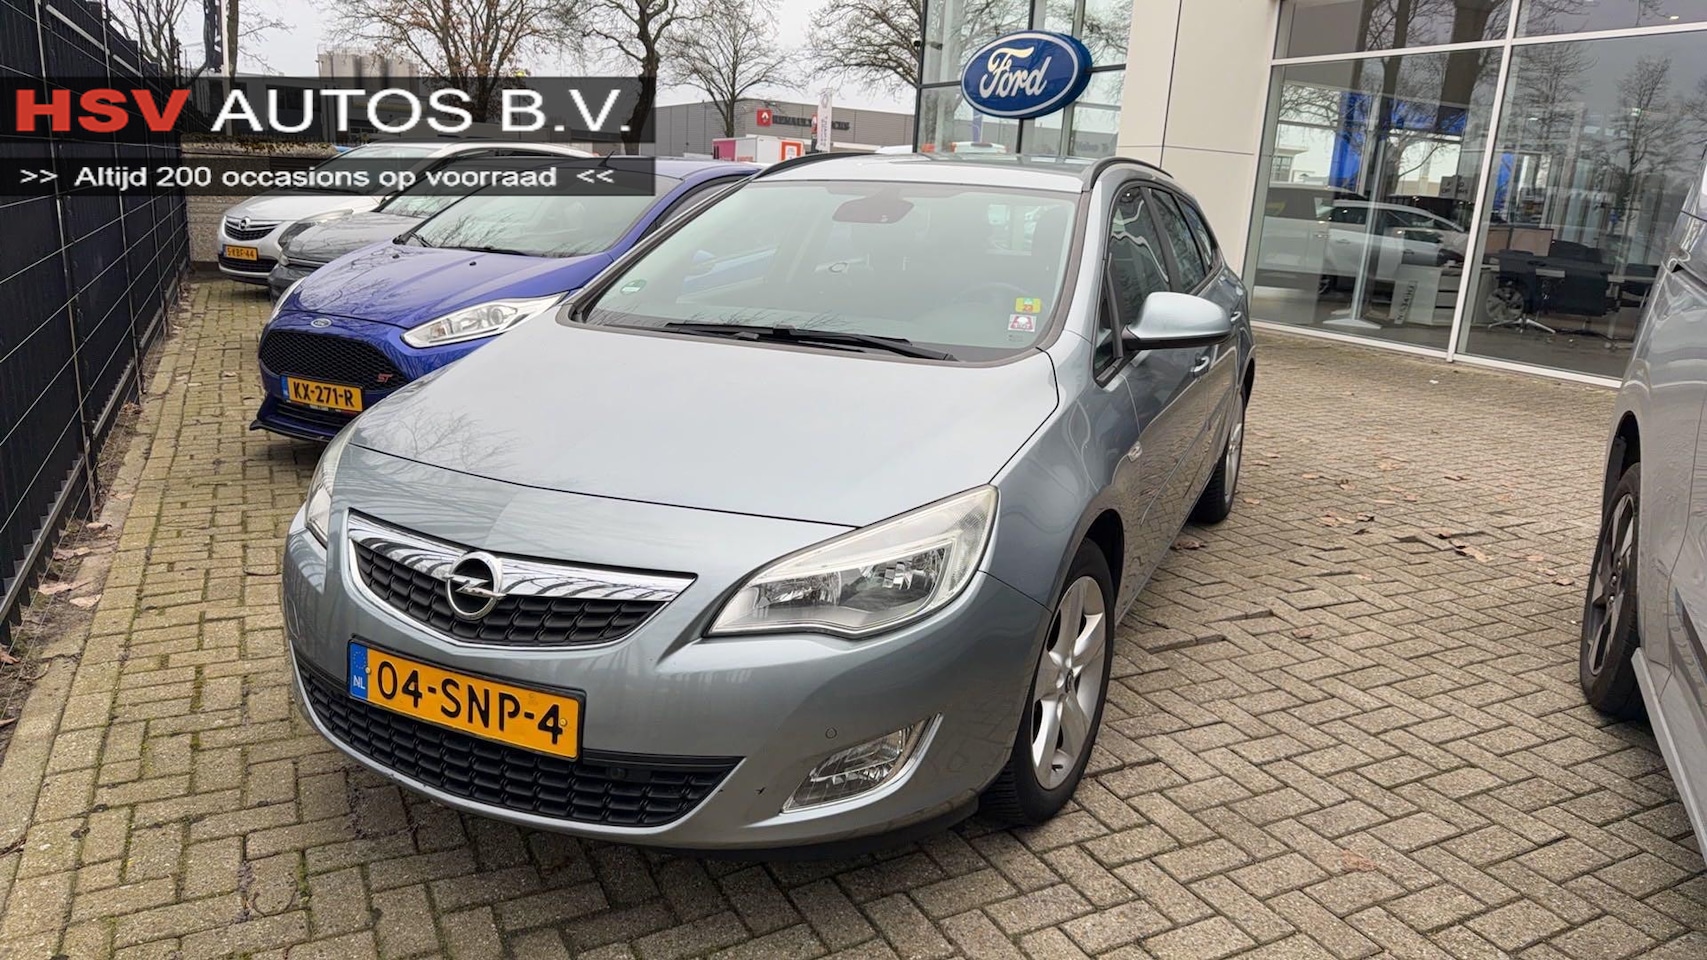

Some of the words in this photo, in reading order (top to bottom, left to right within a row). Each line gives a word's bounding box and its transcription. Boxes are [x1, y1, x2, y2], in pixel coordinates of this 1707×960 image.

[978, 46, 1053, 99] Ford
[293, 381, 355, 408] KX-271-R
[353, 675, 366, 690] NL
[377, 661, 564, 745] 04-SNP-4
